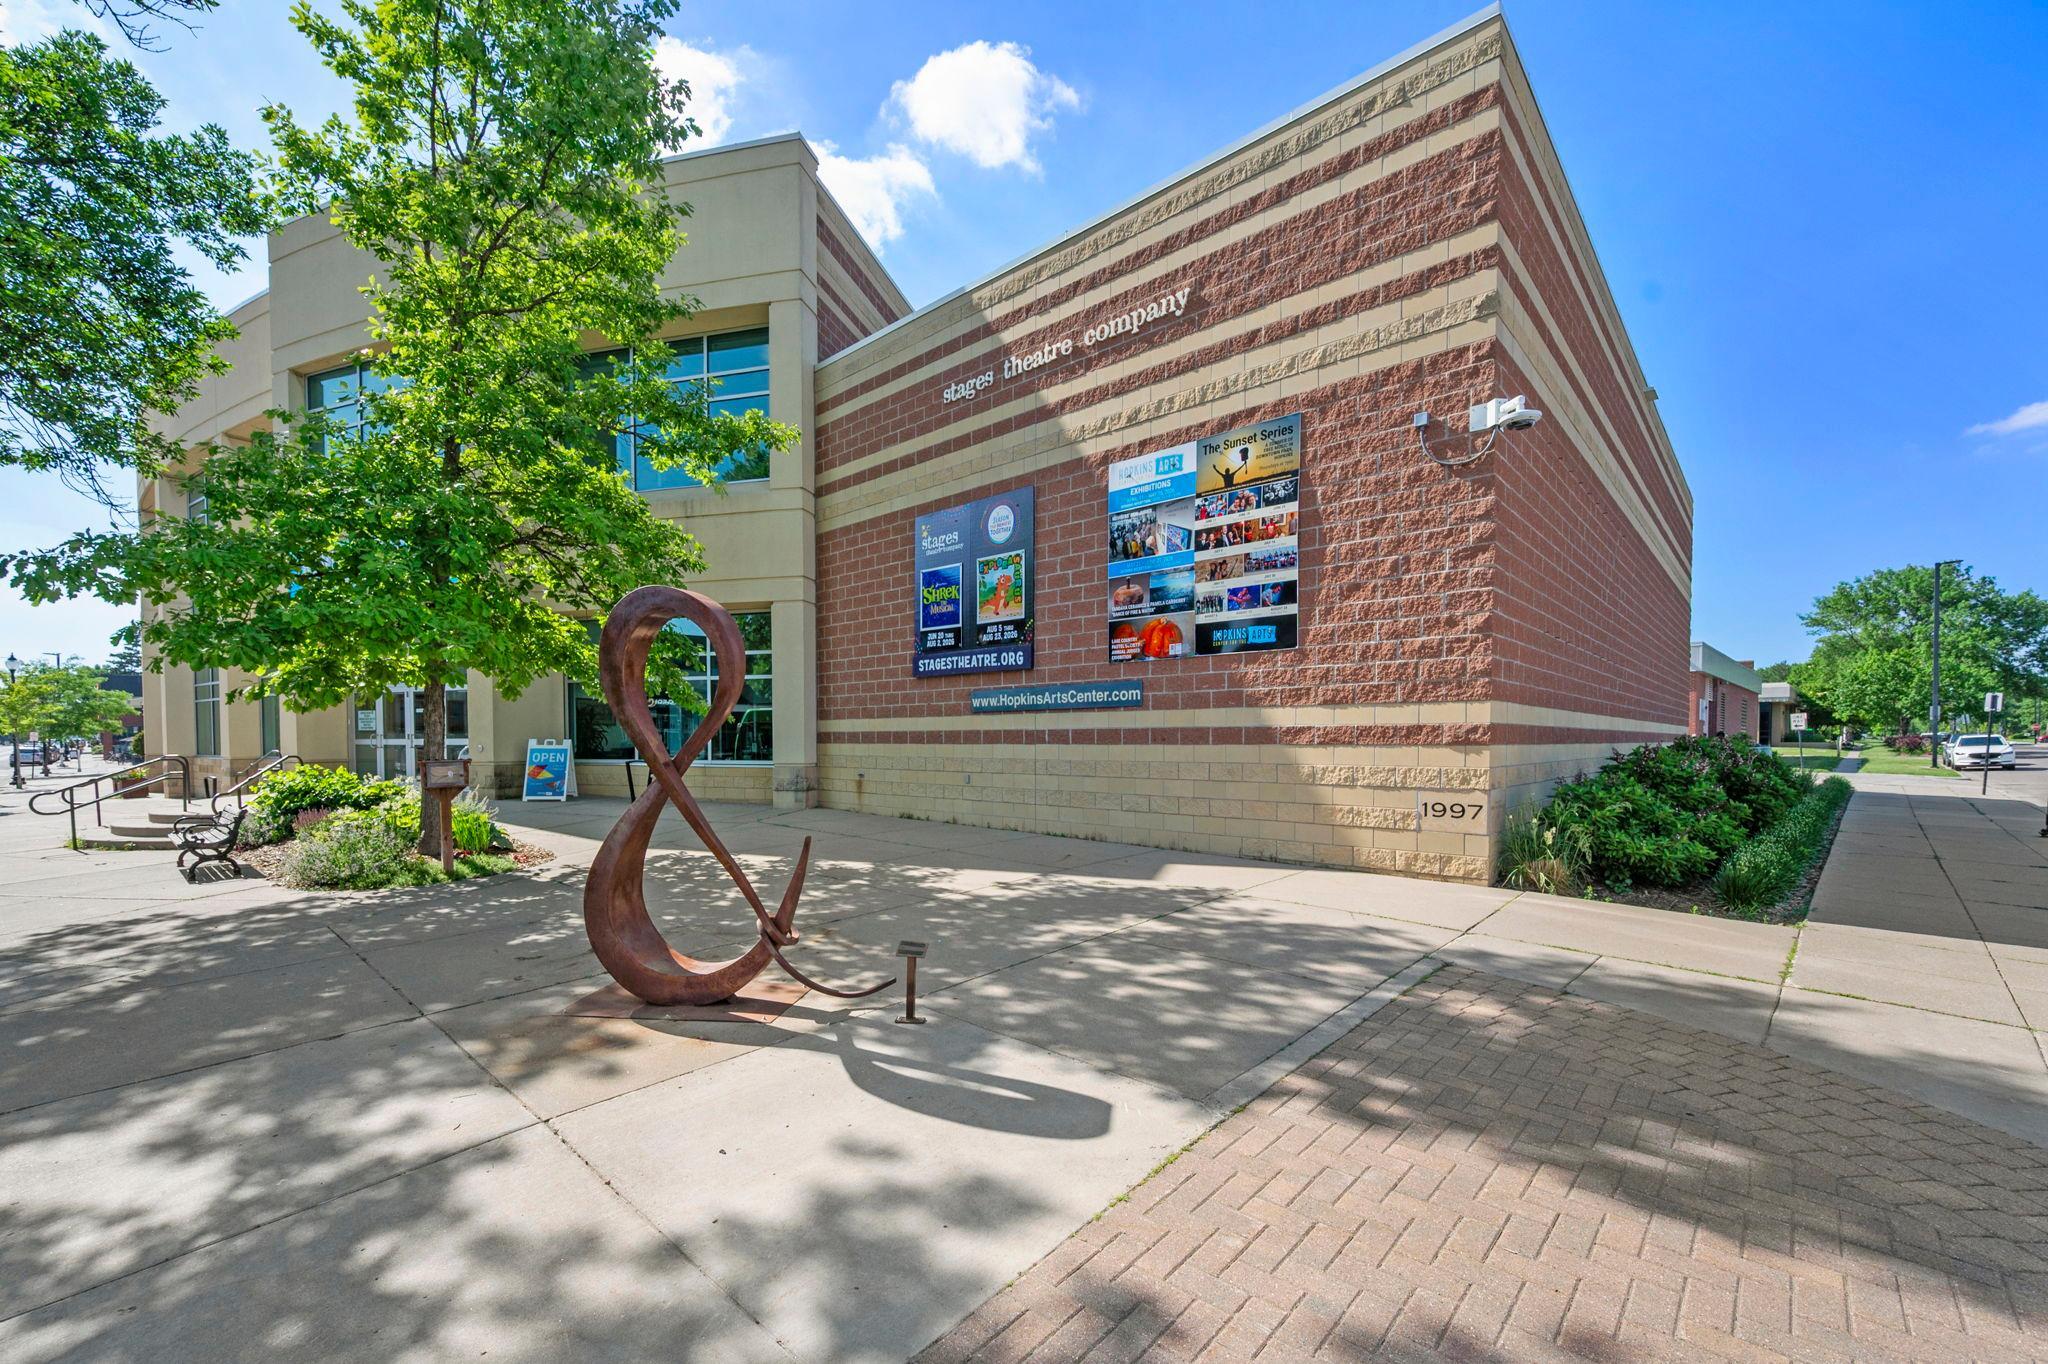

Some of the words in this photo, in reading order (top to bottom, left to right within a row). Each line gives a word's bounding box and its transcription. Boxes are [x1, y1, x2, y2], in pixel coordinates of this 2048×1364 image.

[943, 370, 994, 404] stages
[1003, 336, 1073, 379] theatre
[1084, 287, 1191, 347] company
[1202, 443, 1221, 456] The
[1223, 432, 1257, 450] Sunset
[1260, 425, 1294, 441] Series
[1119, 461, 1153, 480] HOPKINS
[1158, 456, 1180, 474] ARTS
[1130, 480, 1171, 496] EXHIBITIONS
[922, 531, 959, 550] stages
[986, 625, 998, 634] AUG
[1213, 628, 1247, 642] HOPKINS
[1252, 627, 1272, 640] ARTS
[927, 640, 936, 648] AUG
[918, 651, 1024, 672] STAGESTHEATRE.ORG
[972, 689, 1141, 709] www.HopkinsArtsCenter.com
[532, 752, 565, 763] OPEN
[1422, 802, 1483, 820] 1997
